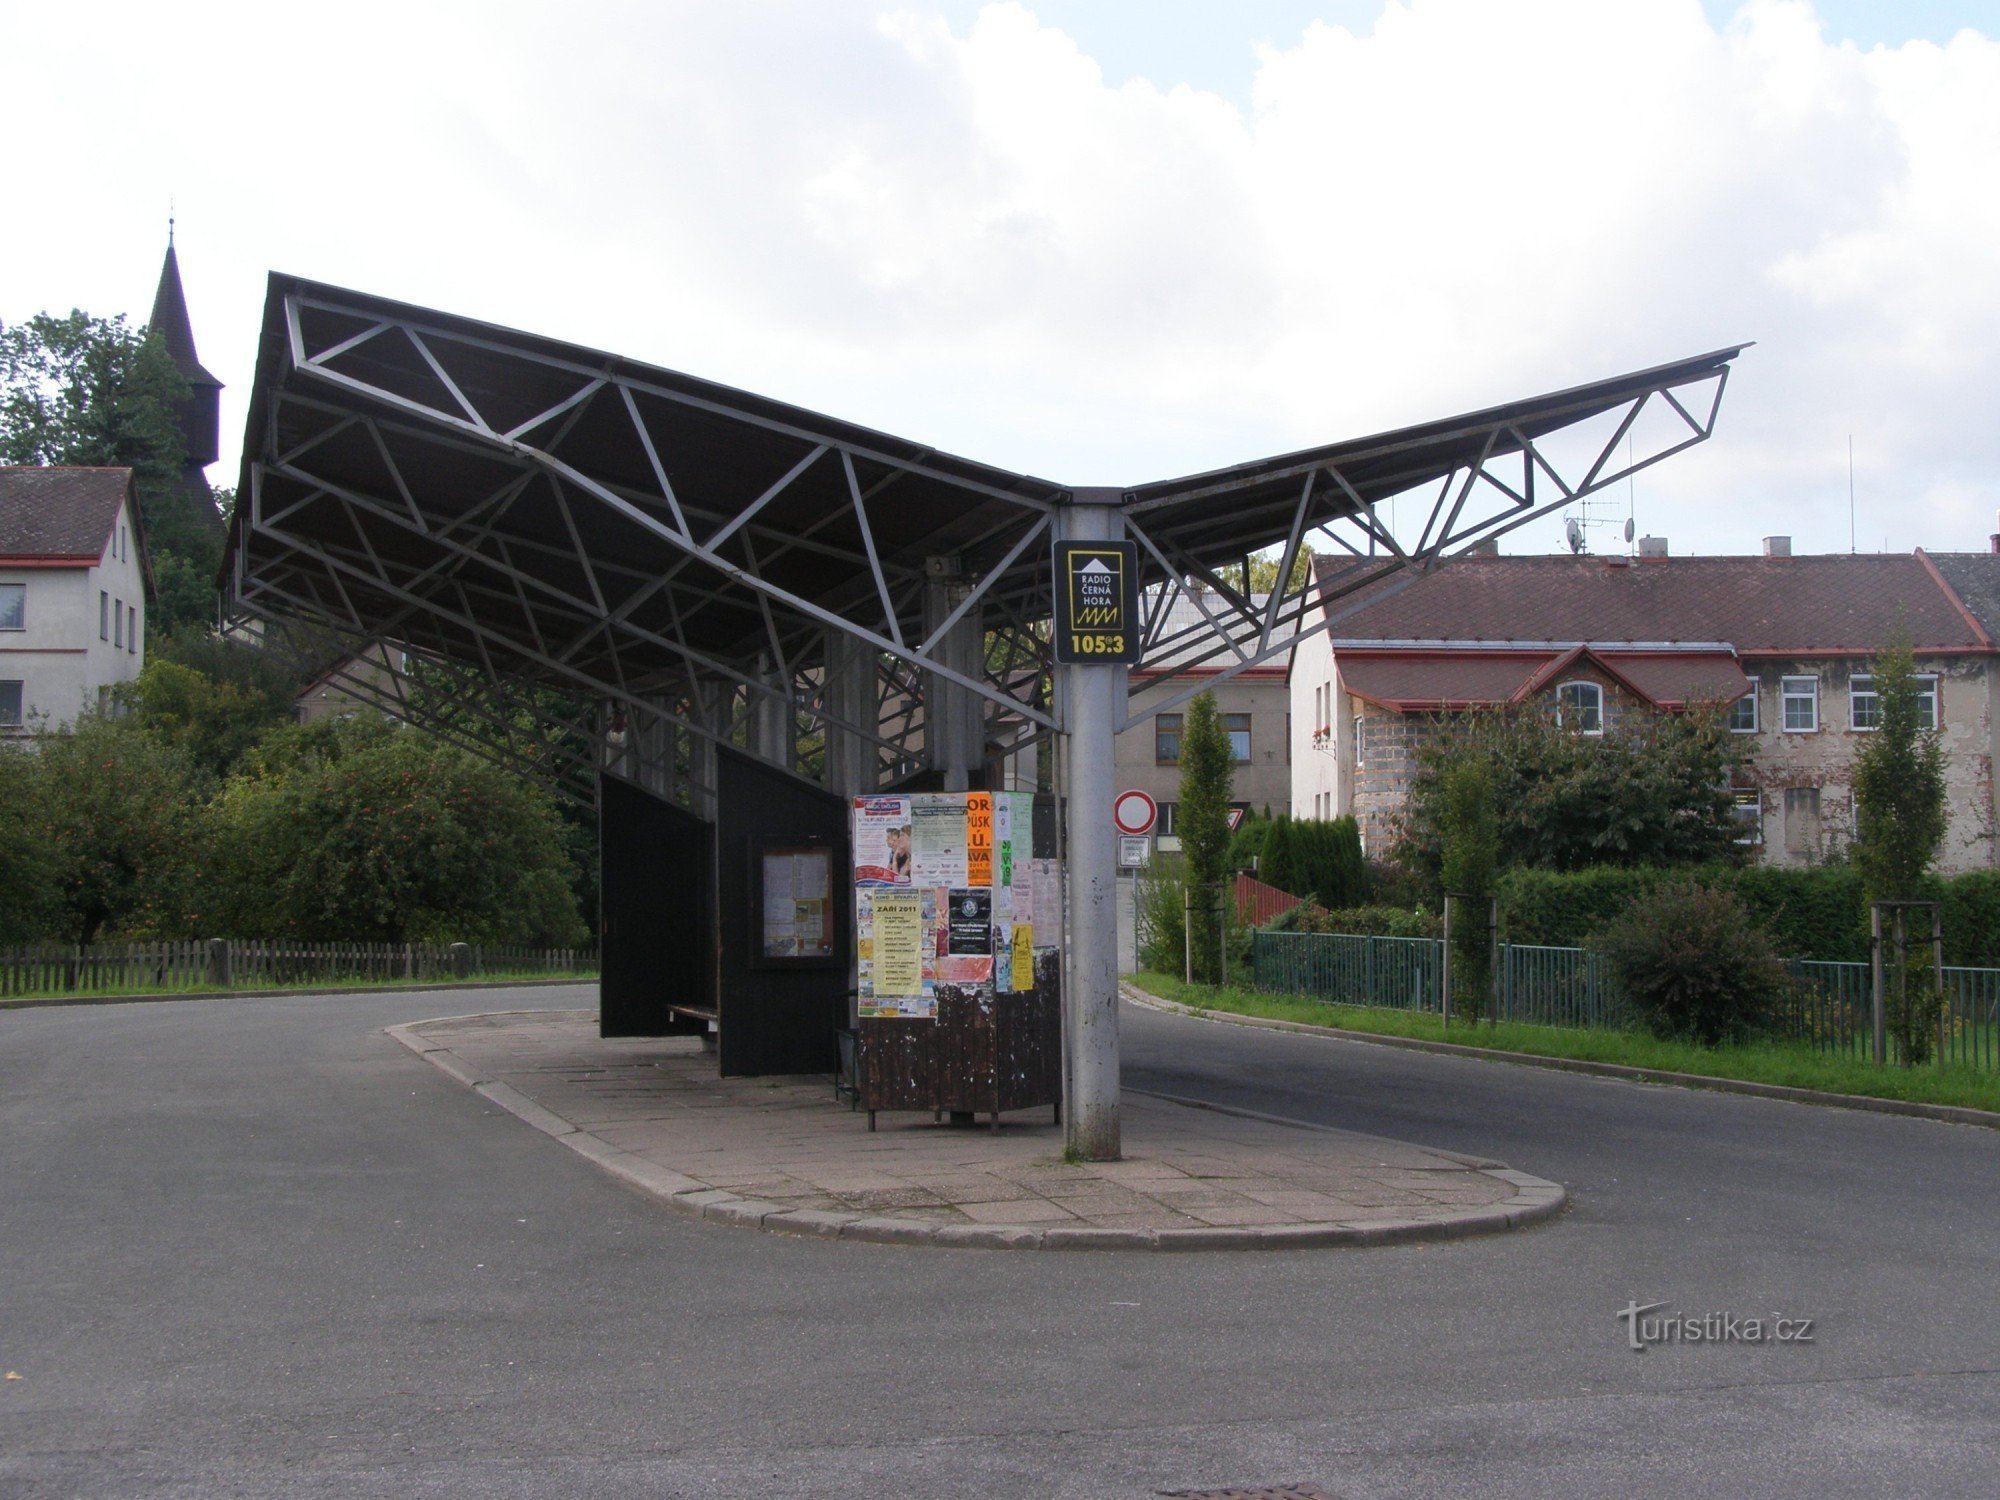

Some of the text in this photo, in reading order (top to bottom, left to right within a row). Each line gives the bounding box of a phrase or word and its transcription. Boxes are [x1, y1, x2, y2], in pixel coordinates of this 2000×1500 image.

[1081, 575, 1111, 584] RADIO
[1081, 584, 1112, 595] ČERNÁ
[1083, 597, 1112, 606] HORA
[1071, 635, 1125, 654] 105.3
